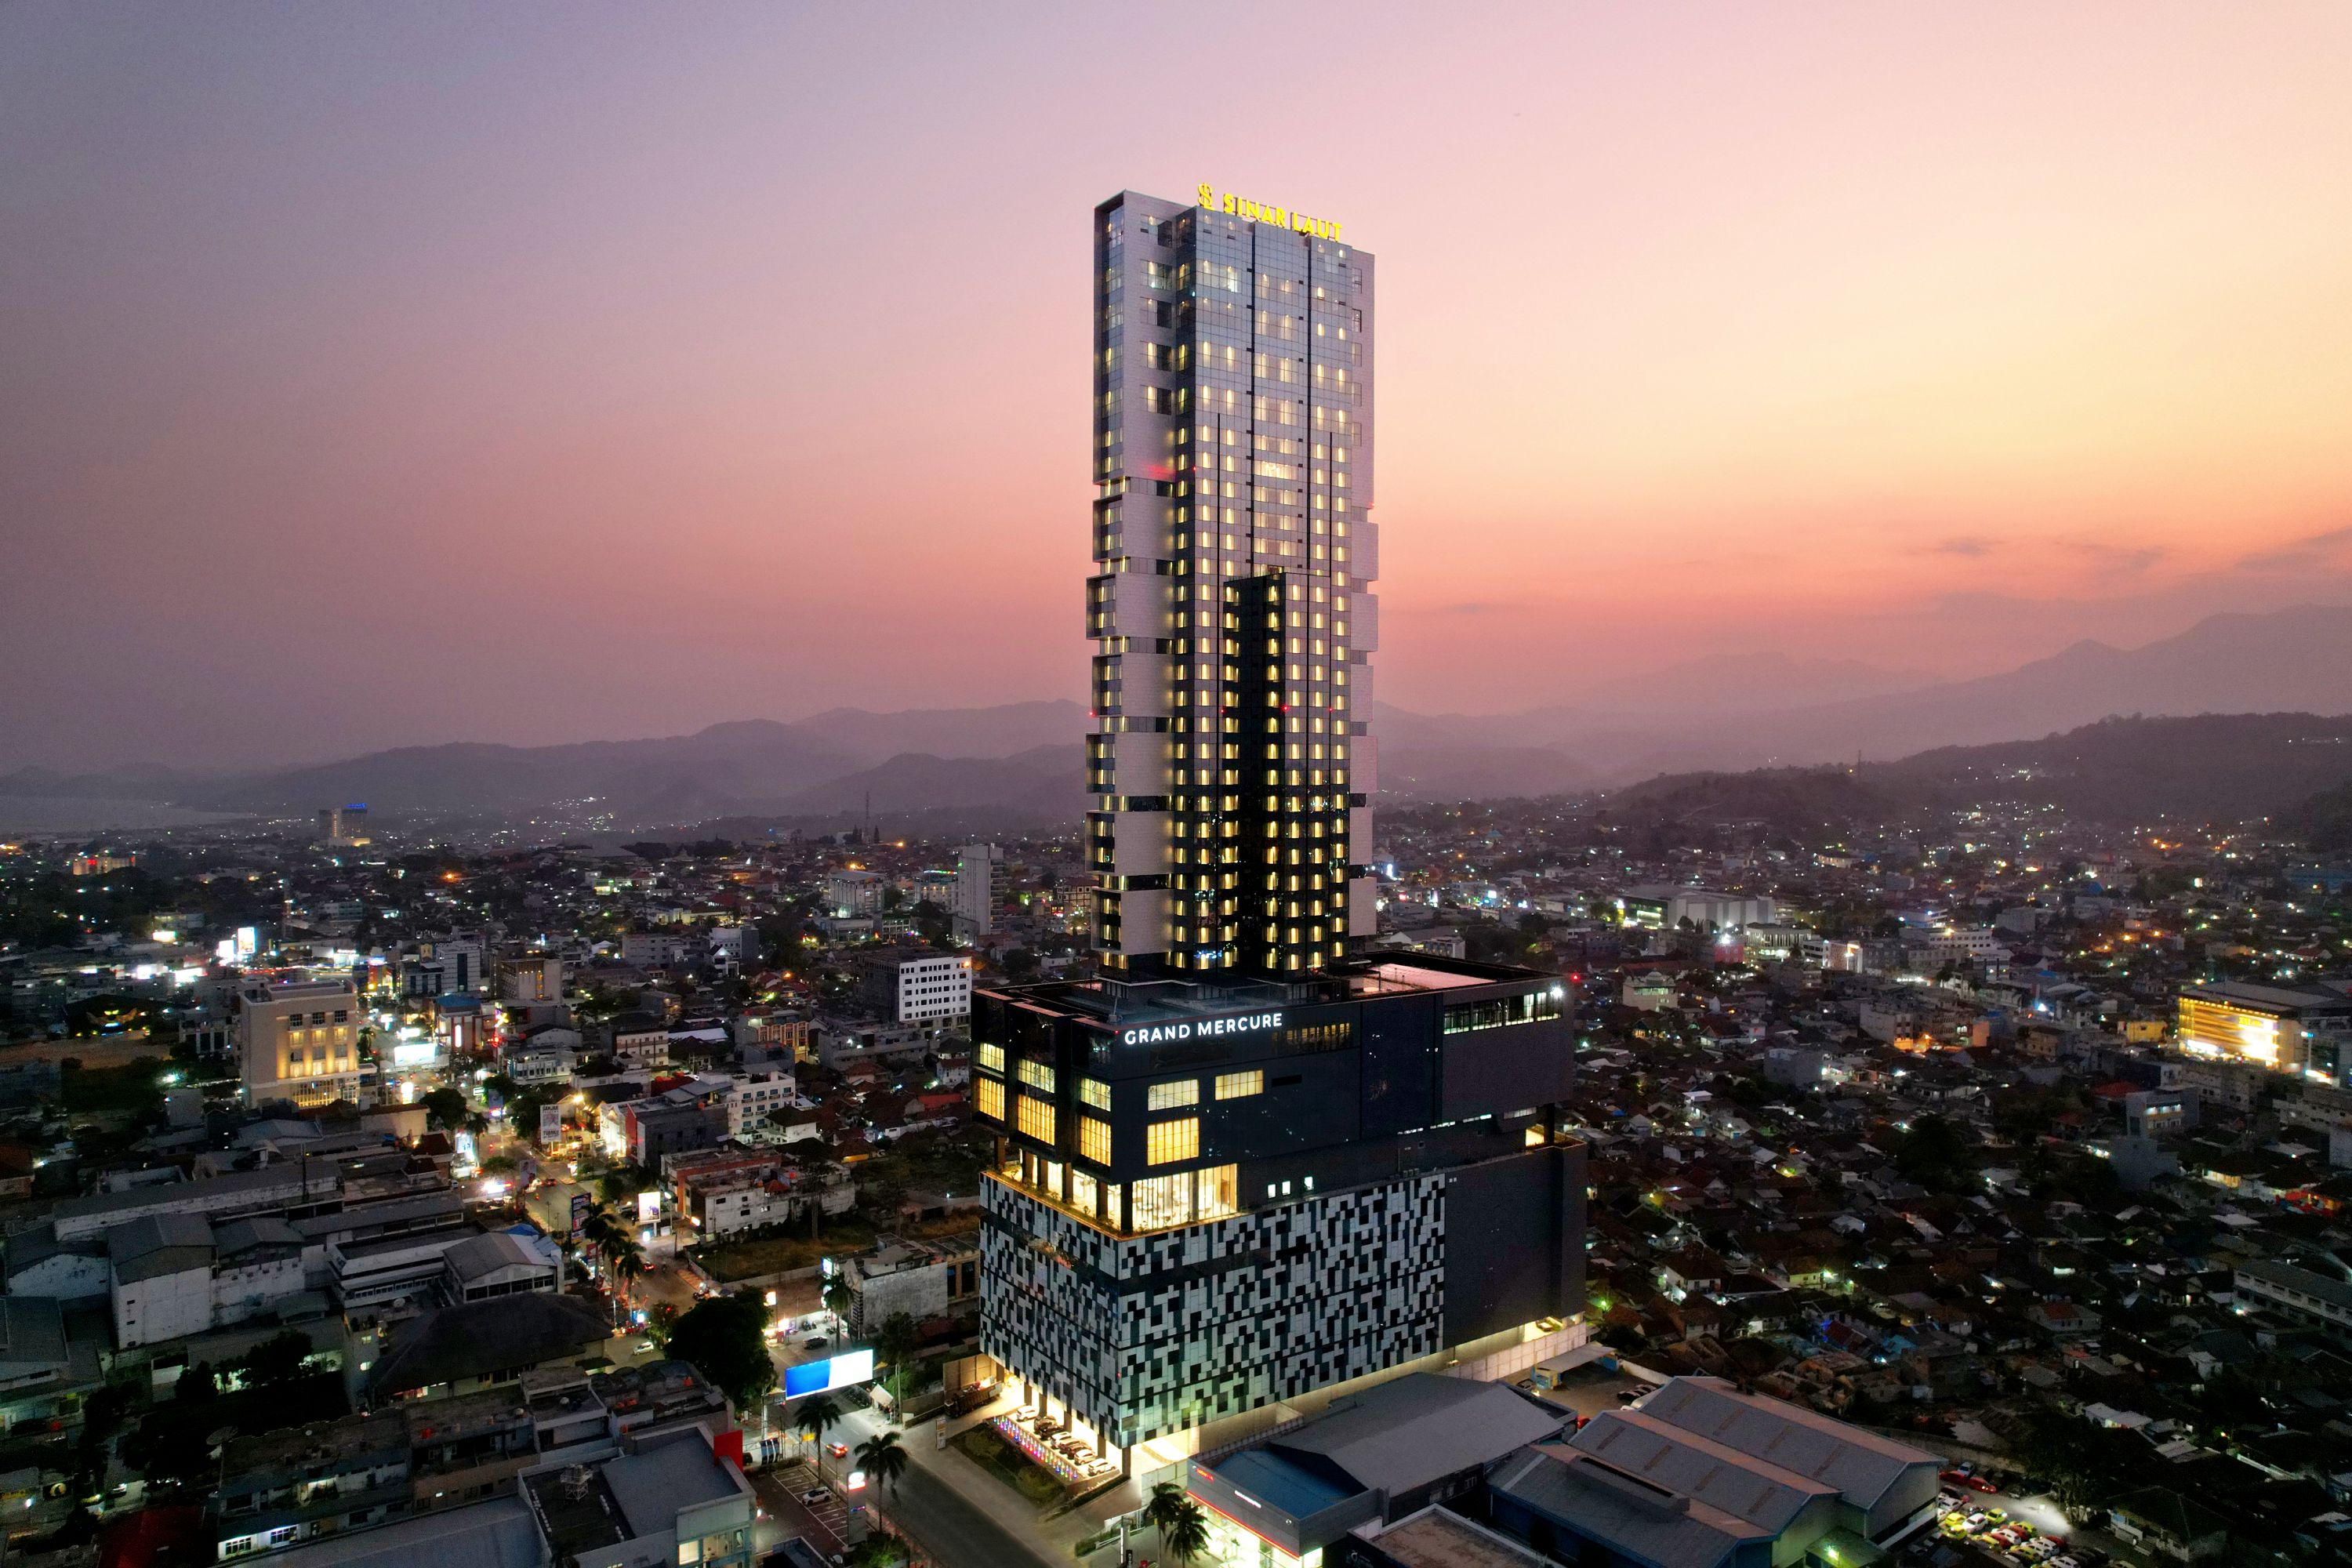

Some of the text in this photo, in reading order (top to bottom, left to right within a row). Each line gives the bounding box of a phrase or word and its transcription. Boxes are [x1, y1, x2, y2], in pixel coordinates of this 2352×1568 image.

[1224, 194, 1286, 228] SINAR
[1293, 212, 1343, 242] LAUT
[1124, 1013, 1283, 1045] GRAND MERCURE
